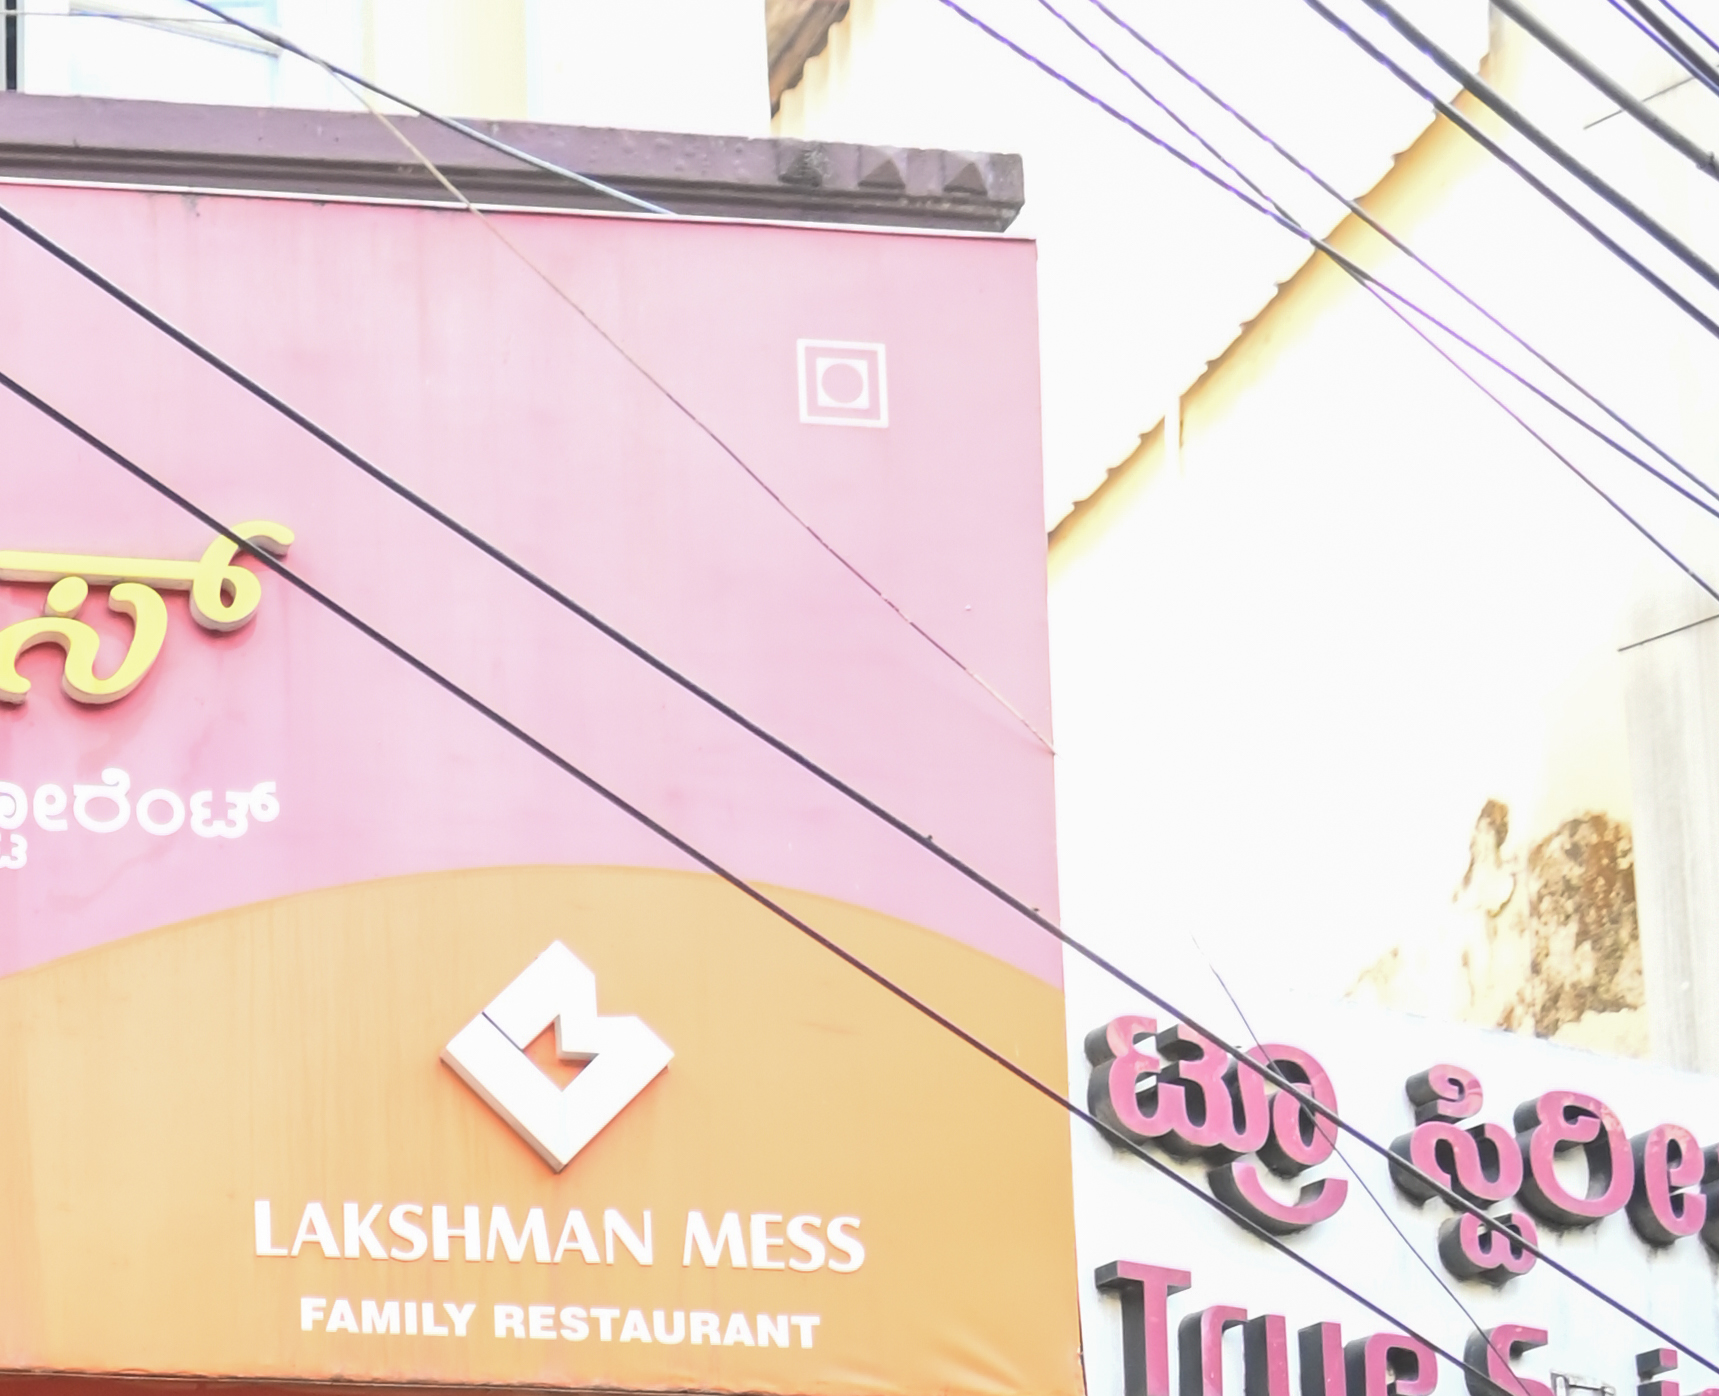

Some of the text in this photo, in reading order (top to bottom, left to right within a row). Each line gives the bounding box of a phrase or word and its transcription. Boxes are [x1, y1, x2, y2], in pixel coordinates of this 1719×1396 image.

[1389, 1063, 1719, 1284] ಸ್ಪಿರೀ
[254, 1200, 866, 1274] LAKSHMAN MESS
[300, 1296, 821, 1350] FAMILY RESTAURANT
